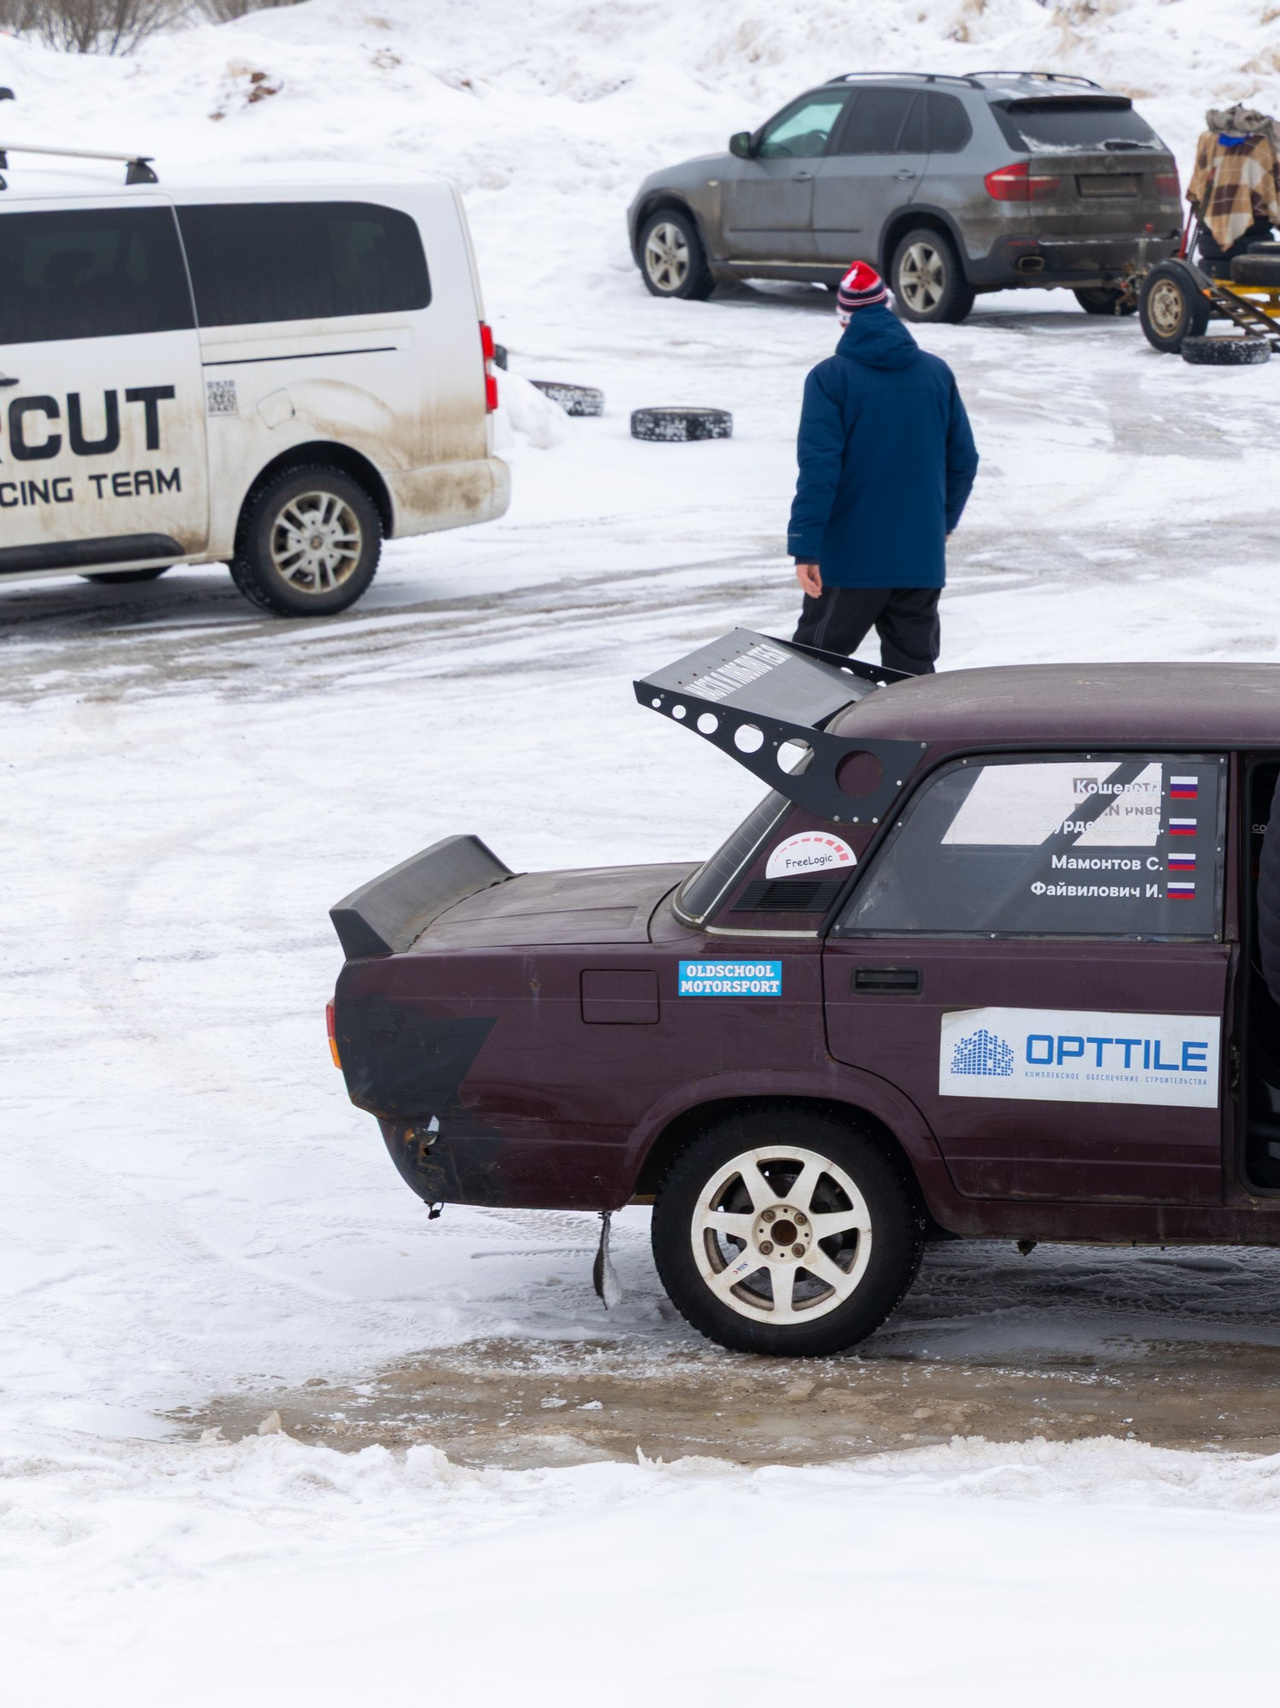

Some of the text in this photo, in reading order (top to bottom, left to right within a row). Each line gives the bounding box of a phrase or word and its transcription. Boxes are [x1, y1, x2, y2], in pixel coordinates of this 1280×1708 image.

[0, 385, 175, 463] CUT
[88, 467, 181, 499] TEAM
[785, 854, 833, 869] FreeLogic
[1051, 855, 1163, 871] Мамонтов С.
[1031, 881, 1163, 898] Файвилович И.
[686, 965, 775, 977] OLDSCHOOL
[681, 980, 779, 993] MOTORSPORT
[1026, 1034, 1208, 1072] OPTTILE
[1024, 1071, 1208, 1085] КОМПЛЕКСНОЕ ОБЕСПЕЧЕНИЕ СТРОИТЕЛЬСТВА
